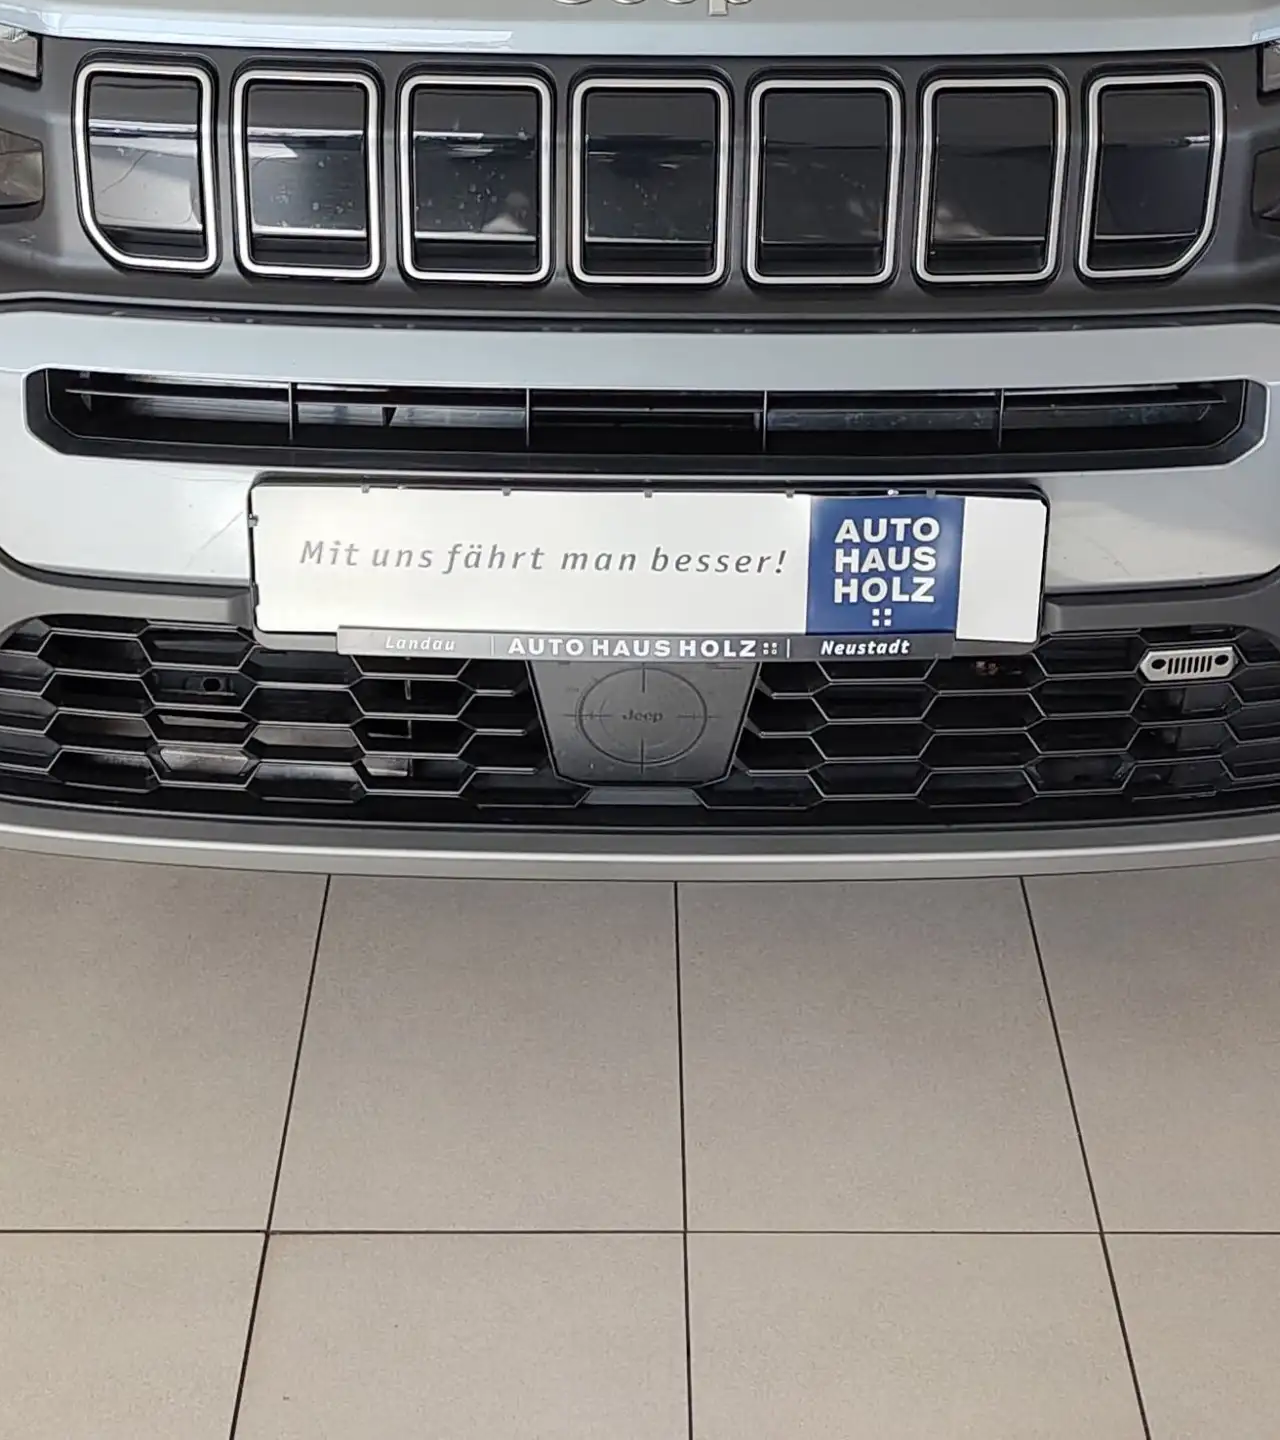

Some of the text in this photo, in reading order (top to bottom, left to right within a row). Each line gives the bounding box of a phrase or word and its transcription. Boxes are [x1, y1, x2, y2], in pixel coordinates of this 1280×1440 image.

[834, 516, 941, 544] AUTO
[299, 540, 788, 575] Mit uns fährt man besser!
[834, 546, 938, 574] HAUS
[833, 576, 936, 604] HOLZ
[385, 635, 457, 652] Landau
[679, 639, 757, 658] HOLZ
[821, 638, 911, 656] Neustadt
[622, 709, 664, 724] Jeep
